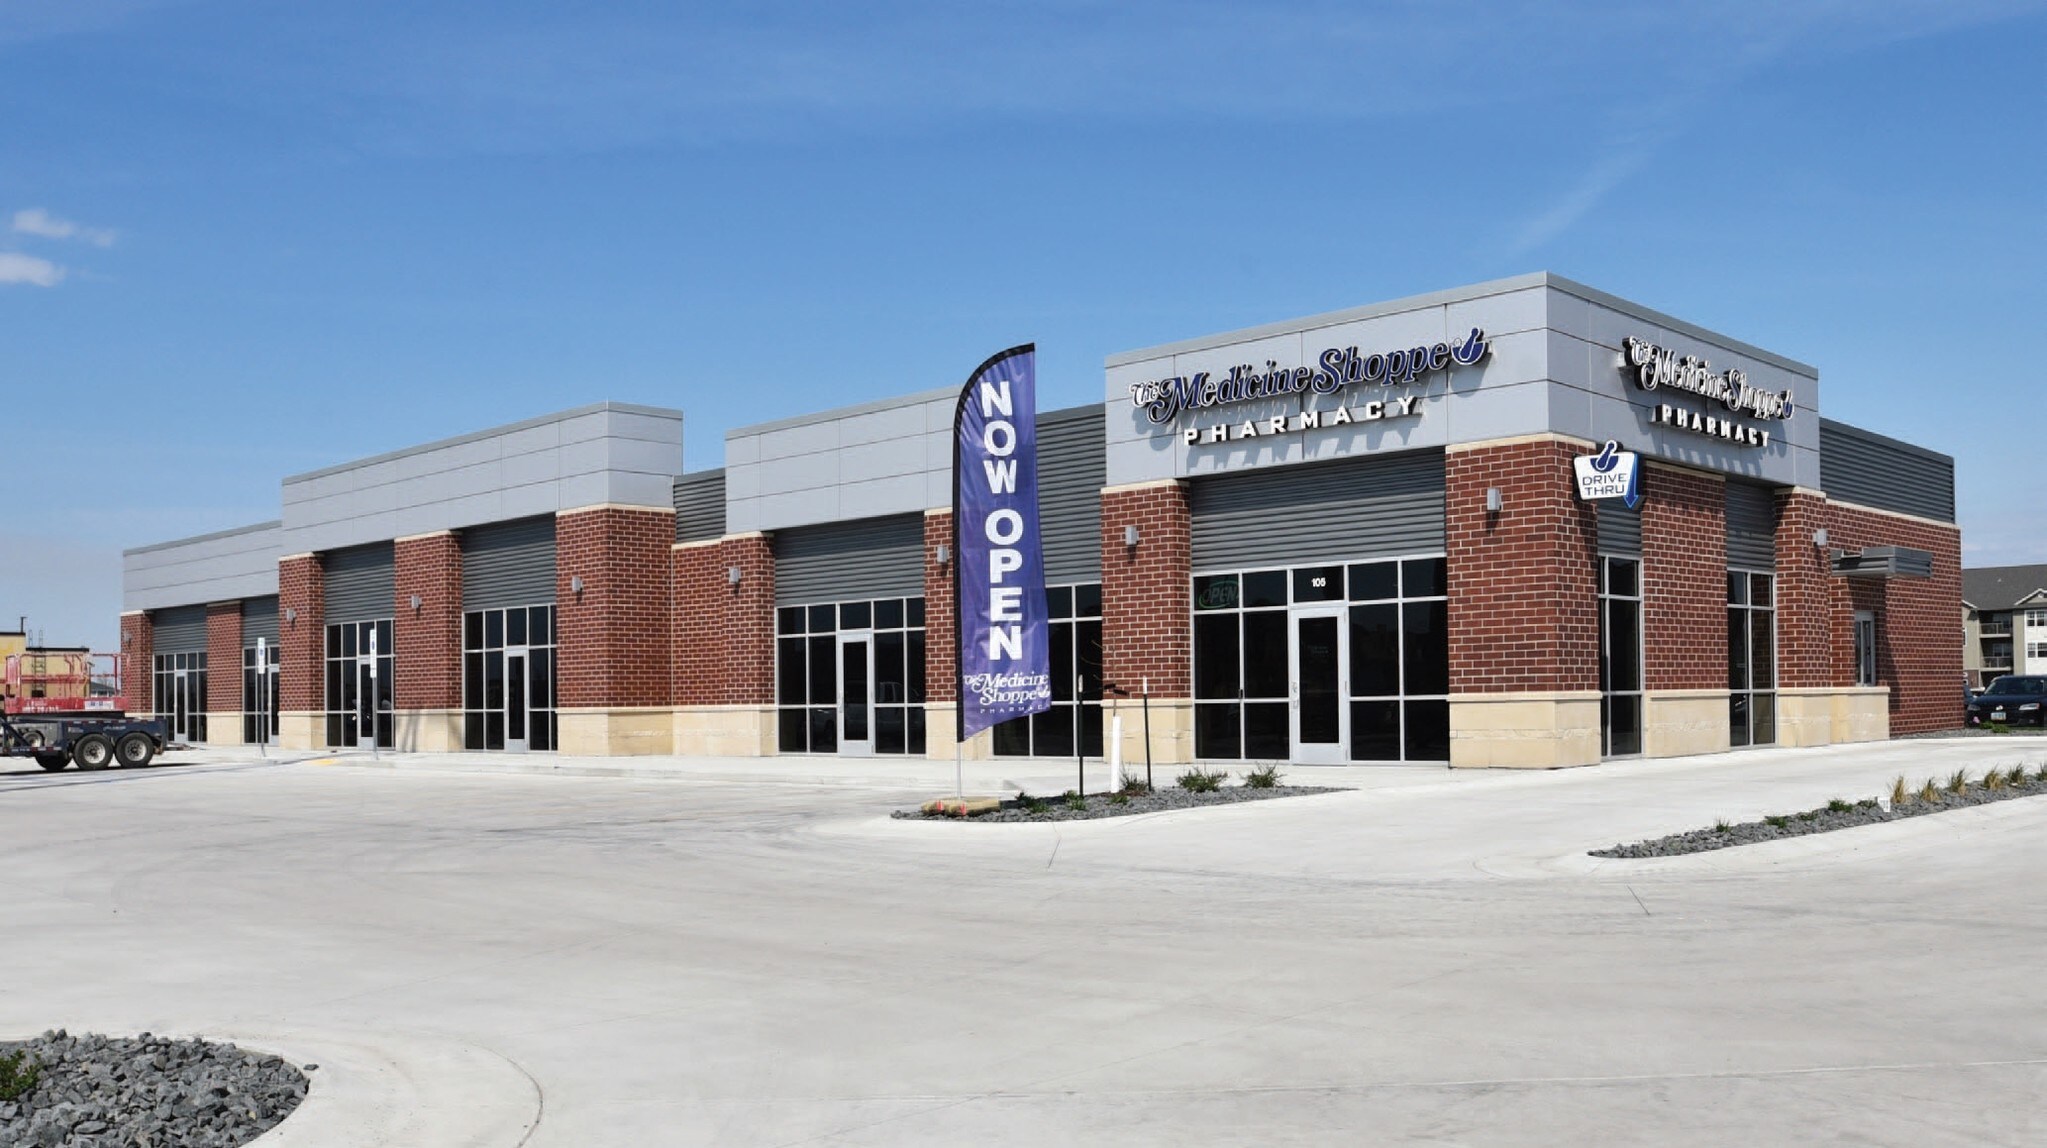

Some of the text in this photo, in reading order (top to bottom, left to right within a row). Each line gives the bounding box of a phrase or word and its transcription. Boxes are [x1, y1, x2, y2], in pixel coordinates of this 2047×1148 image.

[1128, 342, 1449, 424] The Medicine Shoppe
[1641, 346, 1726, 402] Medicine
[1724, 369, 1783, 420] Shoppe
[1184, 396, 1418, 446] PHARMACY
[1661, 403, 1770, 448] PHARMACY
[980, 380, 1017, 495] NOW
[1582, 472, 1627, 486] DRIVE
[1583, 483, 1626, 495] THRU
[985, 508, 1024, 661] OPEN
[1311, 577, 1326, 587] 105
[1202, 586, 1238, 604] OPEN
[971, 670, 1049, 693] Medicine
[980, 687, 1038, 706] Shoppe
[980, 704, 1044, 714] PHARMAC
